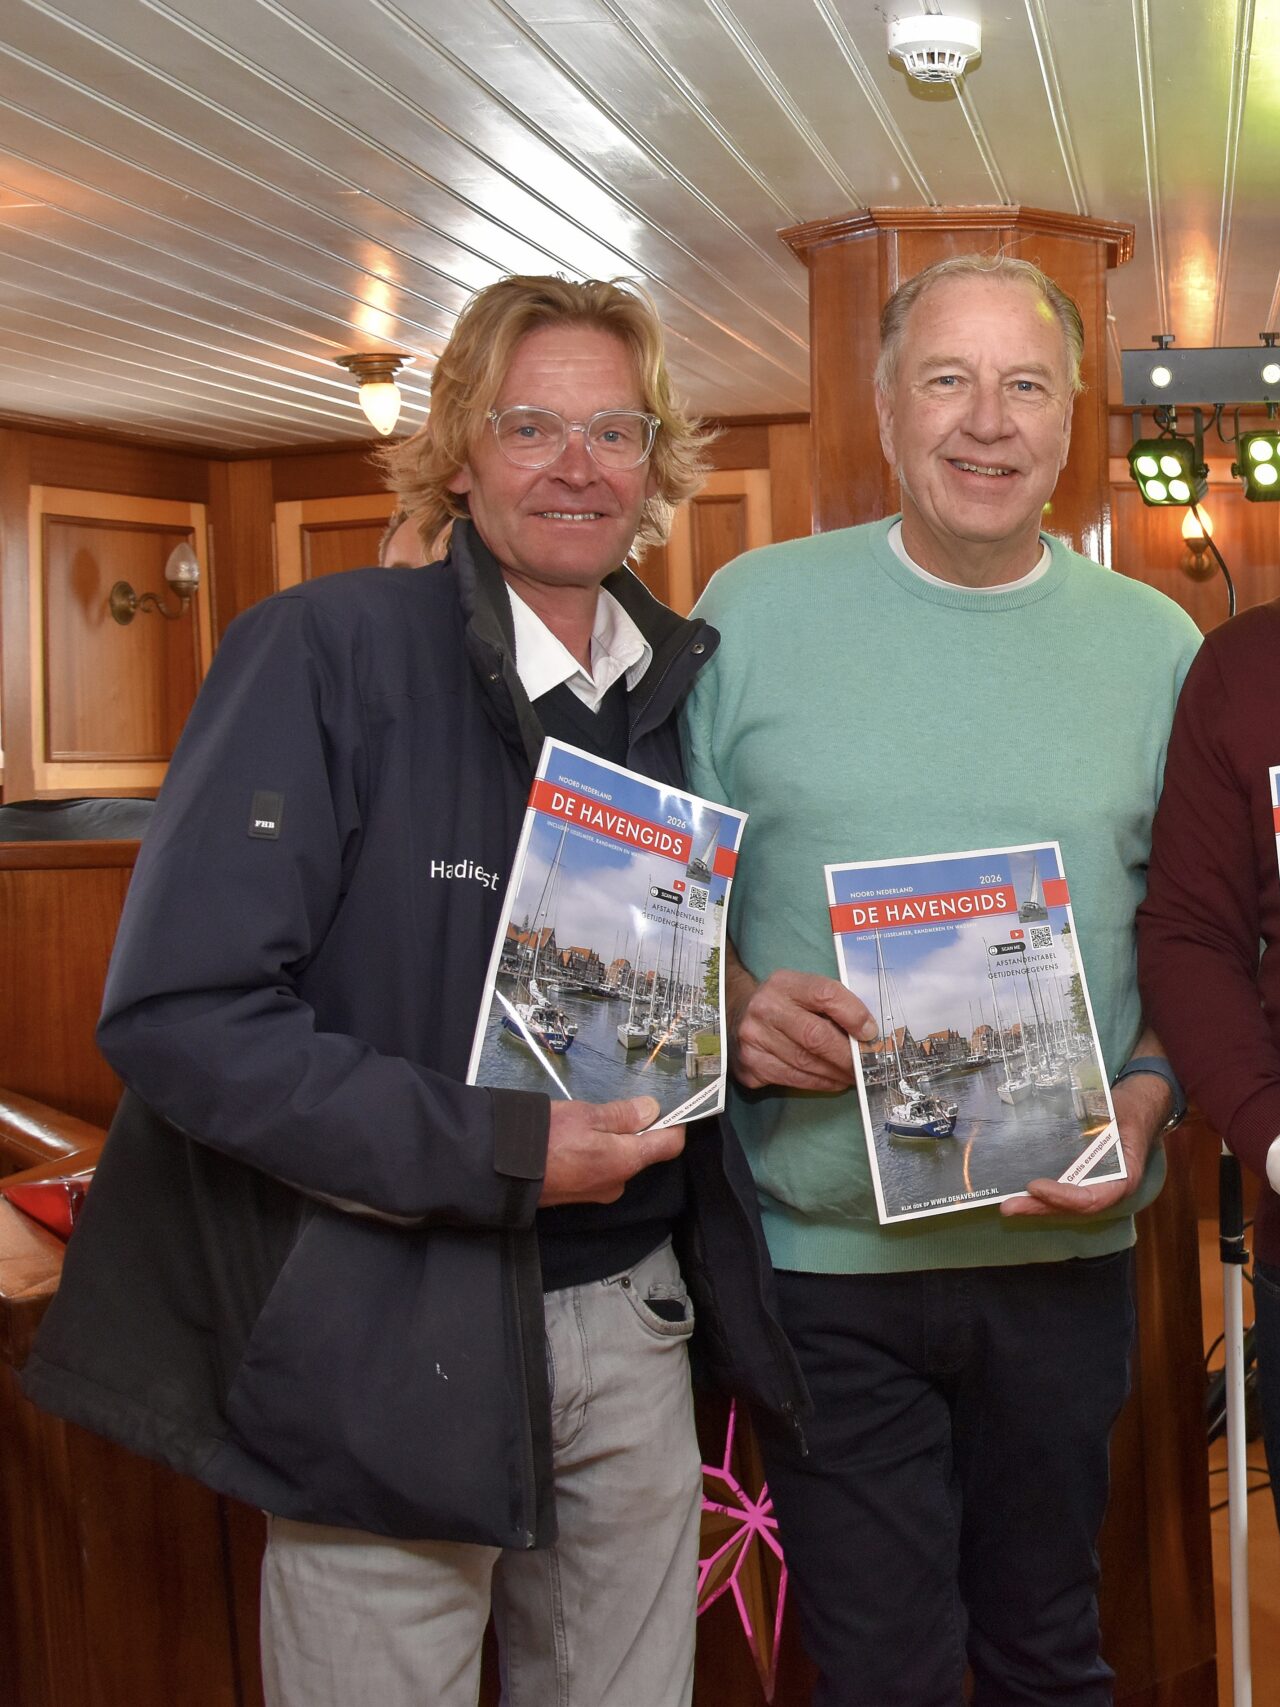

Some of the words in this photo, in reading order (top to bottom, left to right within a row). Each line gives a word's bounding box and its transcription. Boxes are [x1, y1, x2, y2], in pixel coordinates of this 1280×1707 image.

[558, 775, 580, 788] NOORD
[581, 784, 612, 801] NEDERLAND
[551, 792, 576, 816] DE
[580, 803, 683, 854] HAVENGIDS
[666, 815, 687, 829] 2026
[979, 874, 1002, 884] 2026
[876, 886, 913, 896] NEDERLAND
[652, 904, 705, 925] AFSTANDENTABEL
[852, 907, 879, 926] DE
[886, 892, 1007, 922] HAVENGIDS
[642, 912, 704, 935] GETIJDENGEGEVENS
[996, 953, 1056, 966] AFSTANDENTABEL
[988, 964, 1059, 979] GETIJDENGEGEVENS
[663, 1110, 684, 1125] Gratis
[684, 1084, 718, 1110] exemplaar
[1066, 1164, 1085, 1182] Gratis
[1084, 1133, 1112, 1164] exemplaar
[930, 1188, 999, 1205] WWW.DEHAVENGIDS.NL
